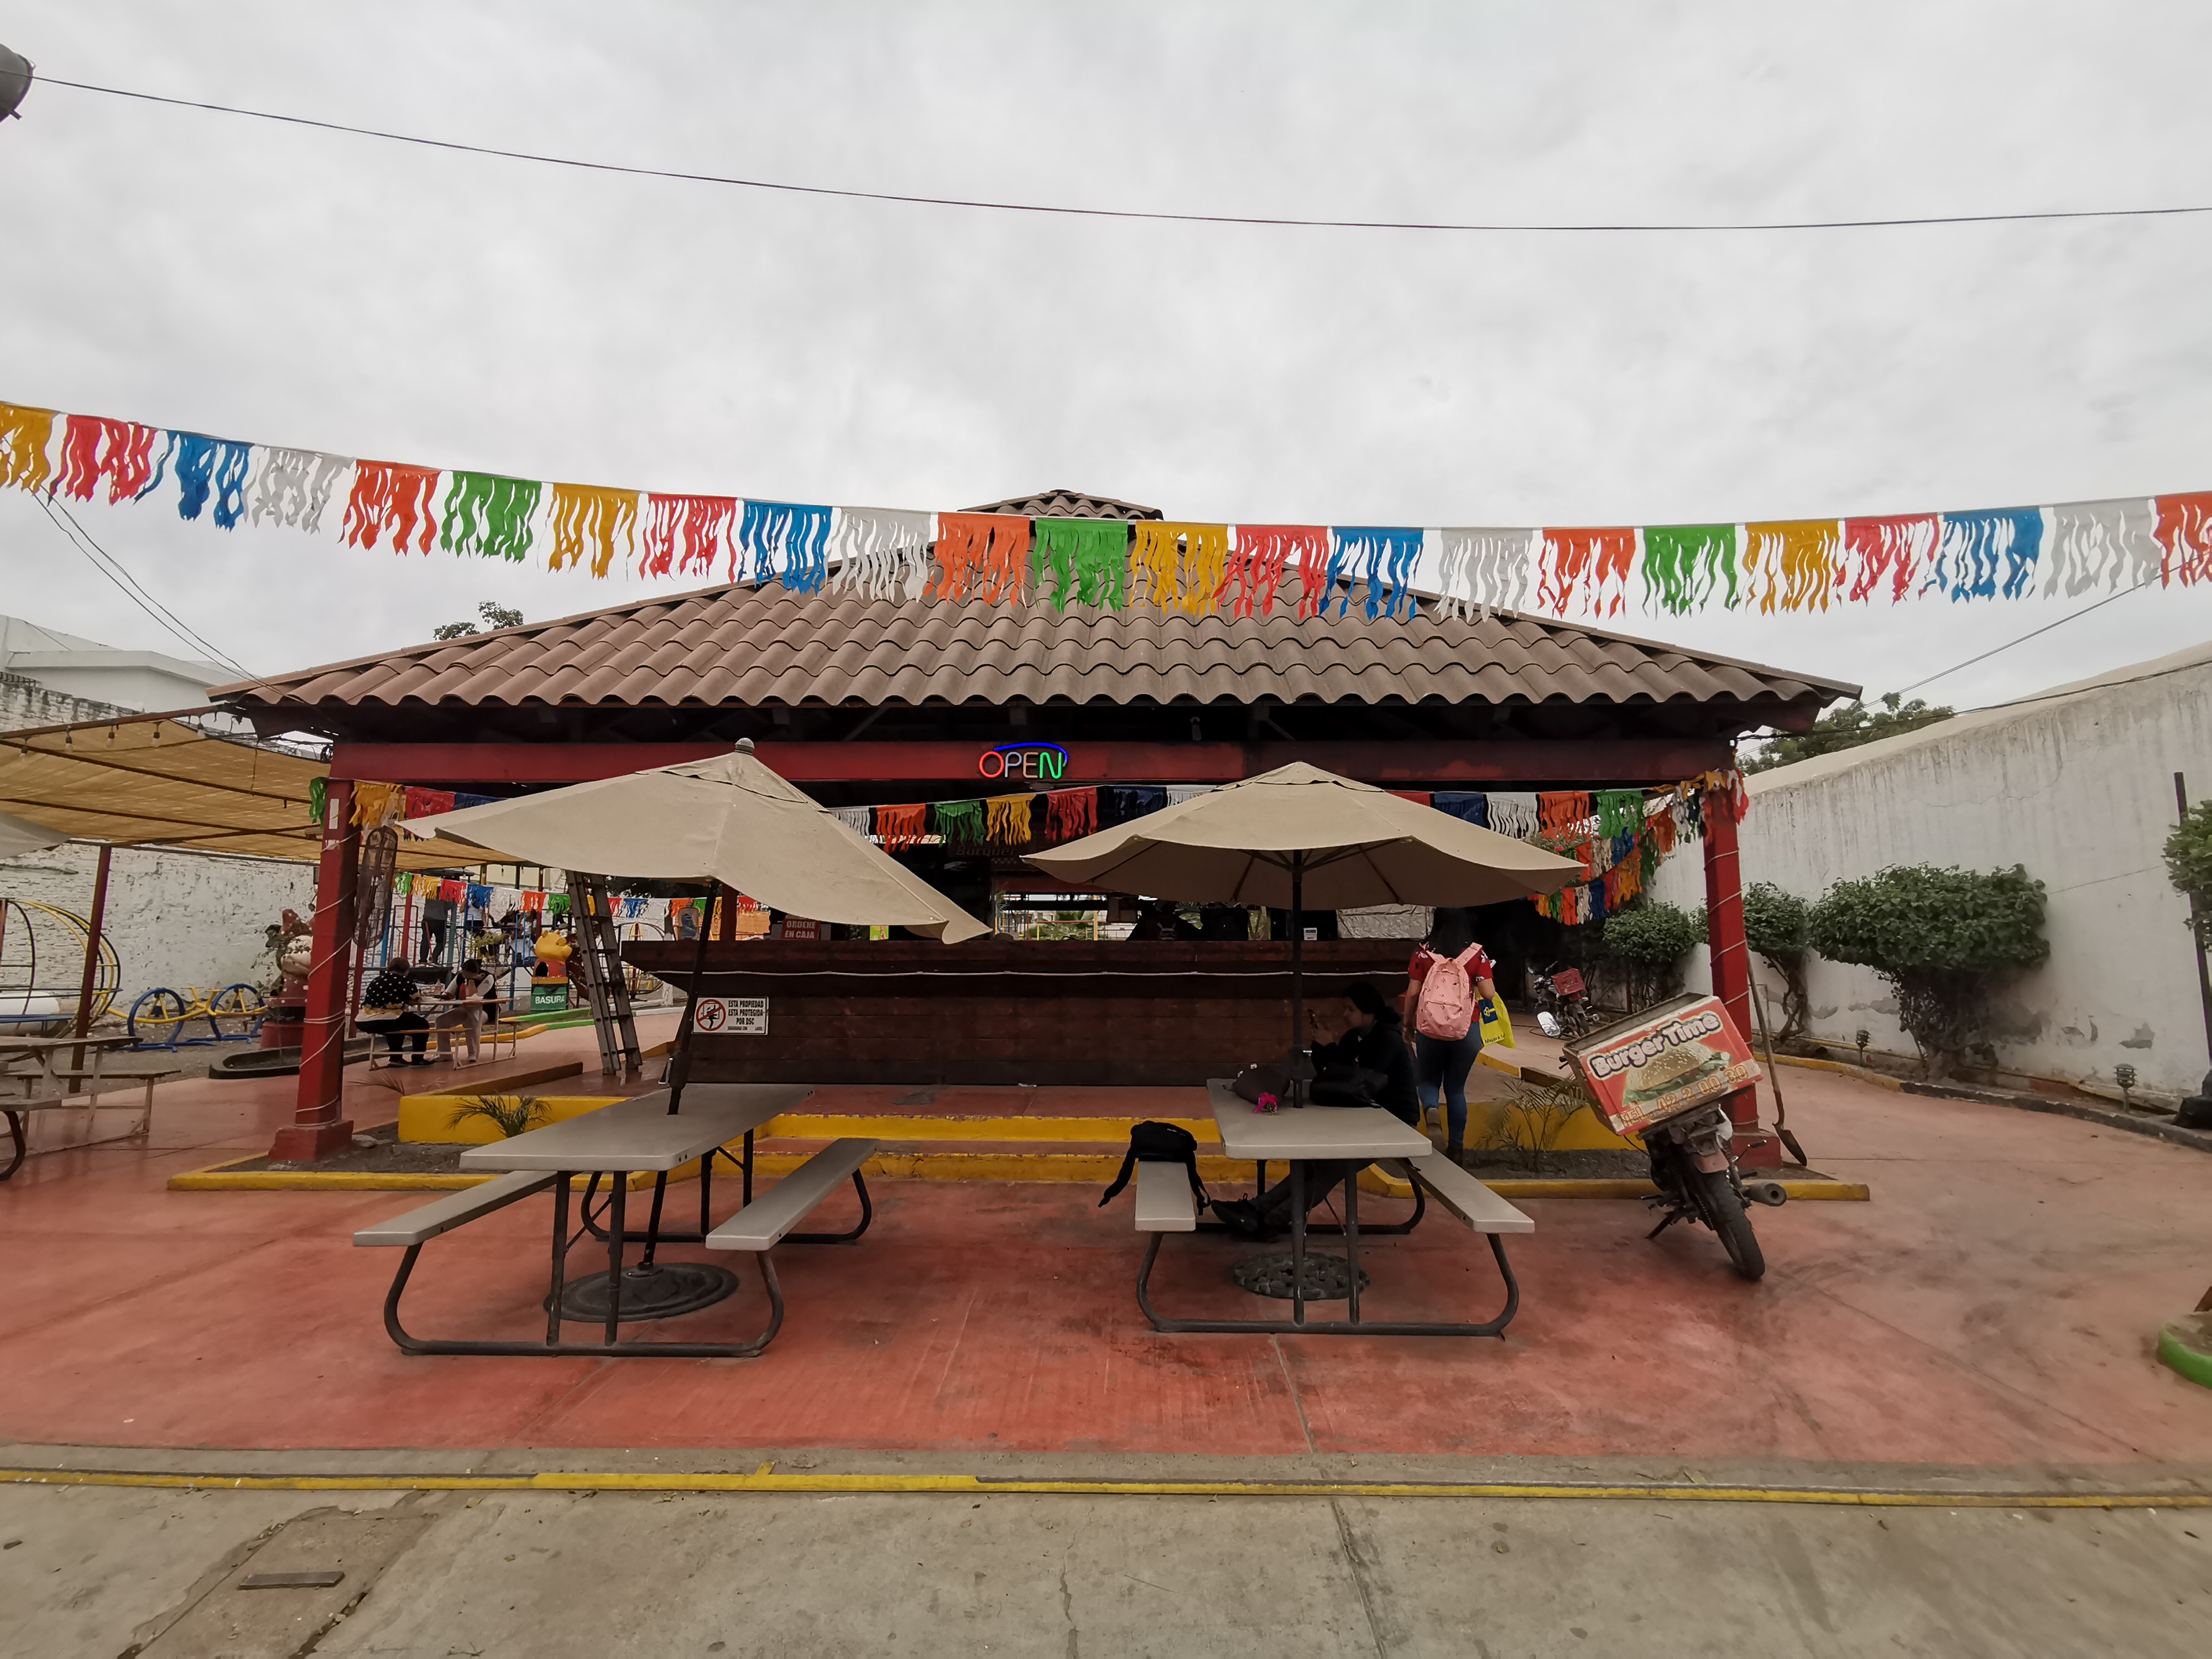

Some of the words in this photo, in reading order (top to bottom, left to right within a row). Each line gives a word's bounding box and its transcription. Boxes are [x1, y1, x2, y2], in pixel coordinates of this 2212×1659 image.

[979, 750, 1062, 780] OPEN
[535, 995, 565, 1004] BASURA
[1617, 1106, 1655, 1128] TEL.
[1656, 1092, 1682, 1112] 42
[1681, 1086, 1696, 1100] 2
[1697, 1075, 1723, 1095] 00
[1723, 1064, 1748, 1084] 30
